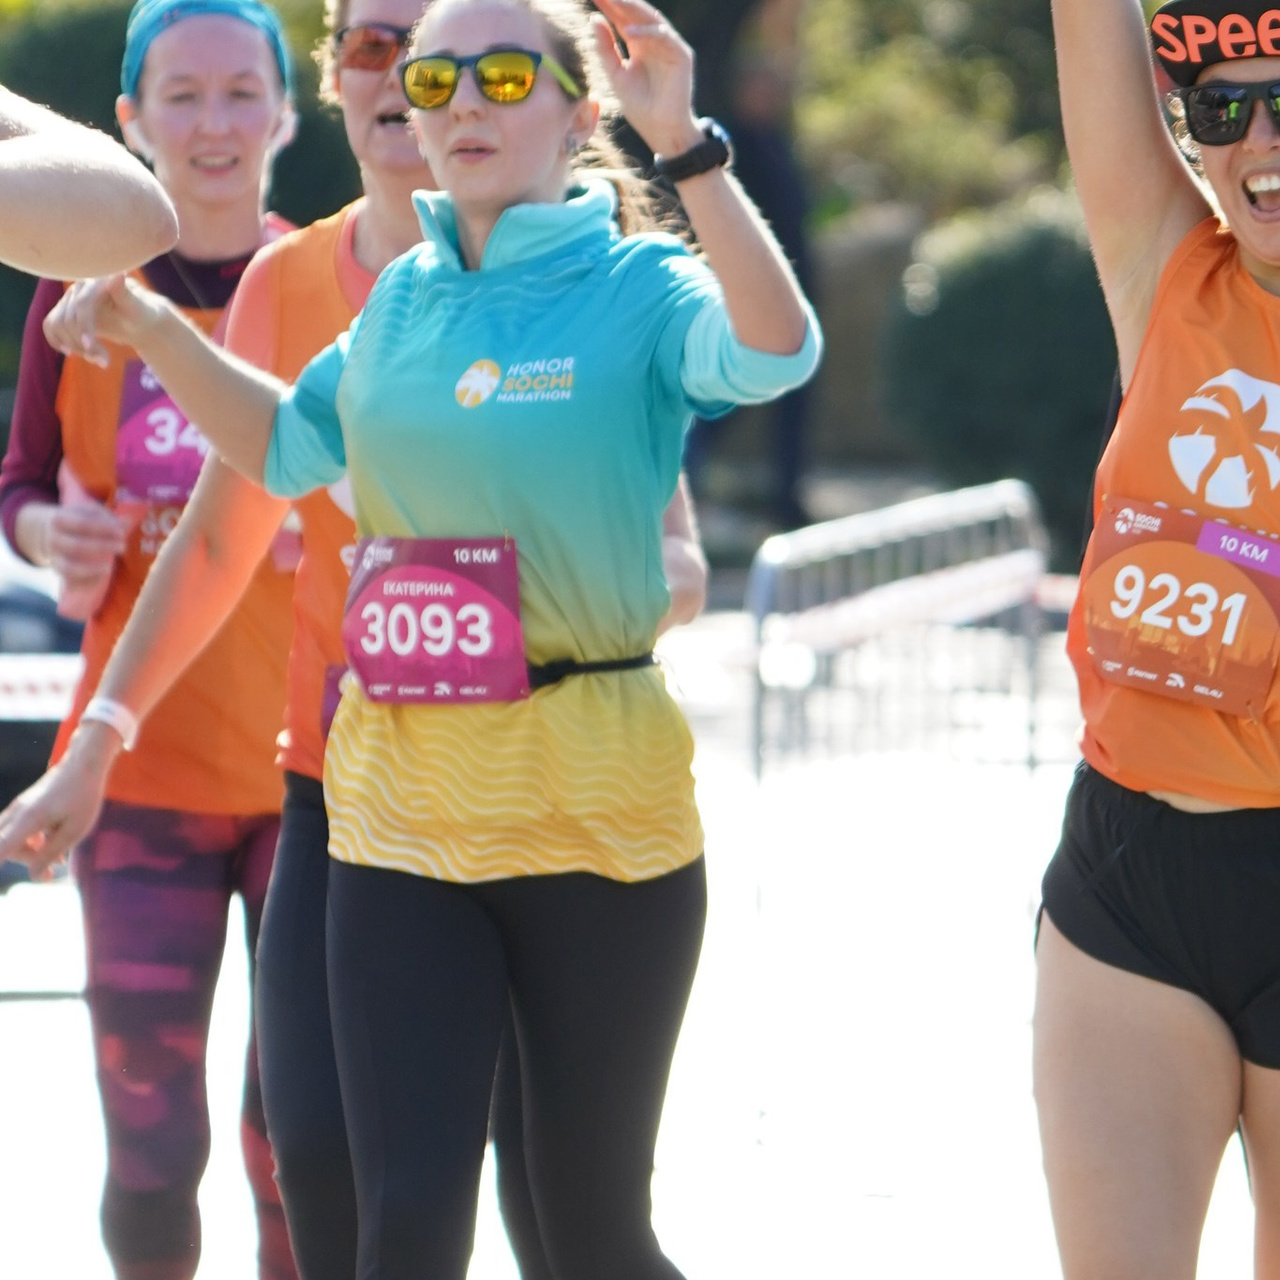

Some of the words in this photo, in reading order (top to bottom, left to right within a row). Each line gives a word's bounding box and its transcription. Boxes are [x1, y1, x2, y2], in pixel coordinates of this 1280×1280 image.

[506, 356, 574, 376] HONOR
[502, 372, 574, 392] SOCHI
[496, 389, 571, 403] MARATHON
[453, 548, 471, 564] 10
[472, 548, 497, 563] KM
[1219, 534, 1238, 552] 10
[1239, 542, 1269, 563] KM
[383, 580, 454, 597] ЕКАТЕРИНА
[1110, 565, 1247, 646] 9231
[360, 601, 492, 656] 3093
